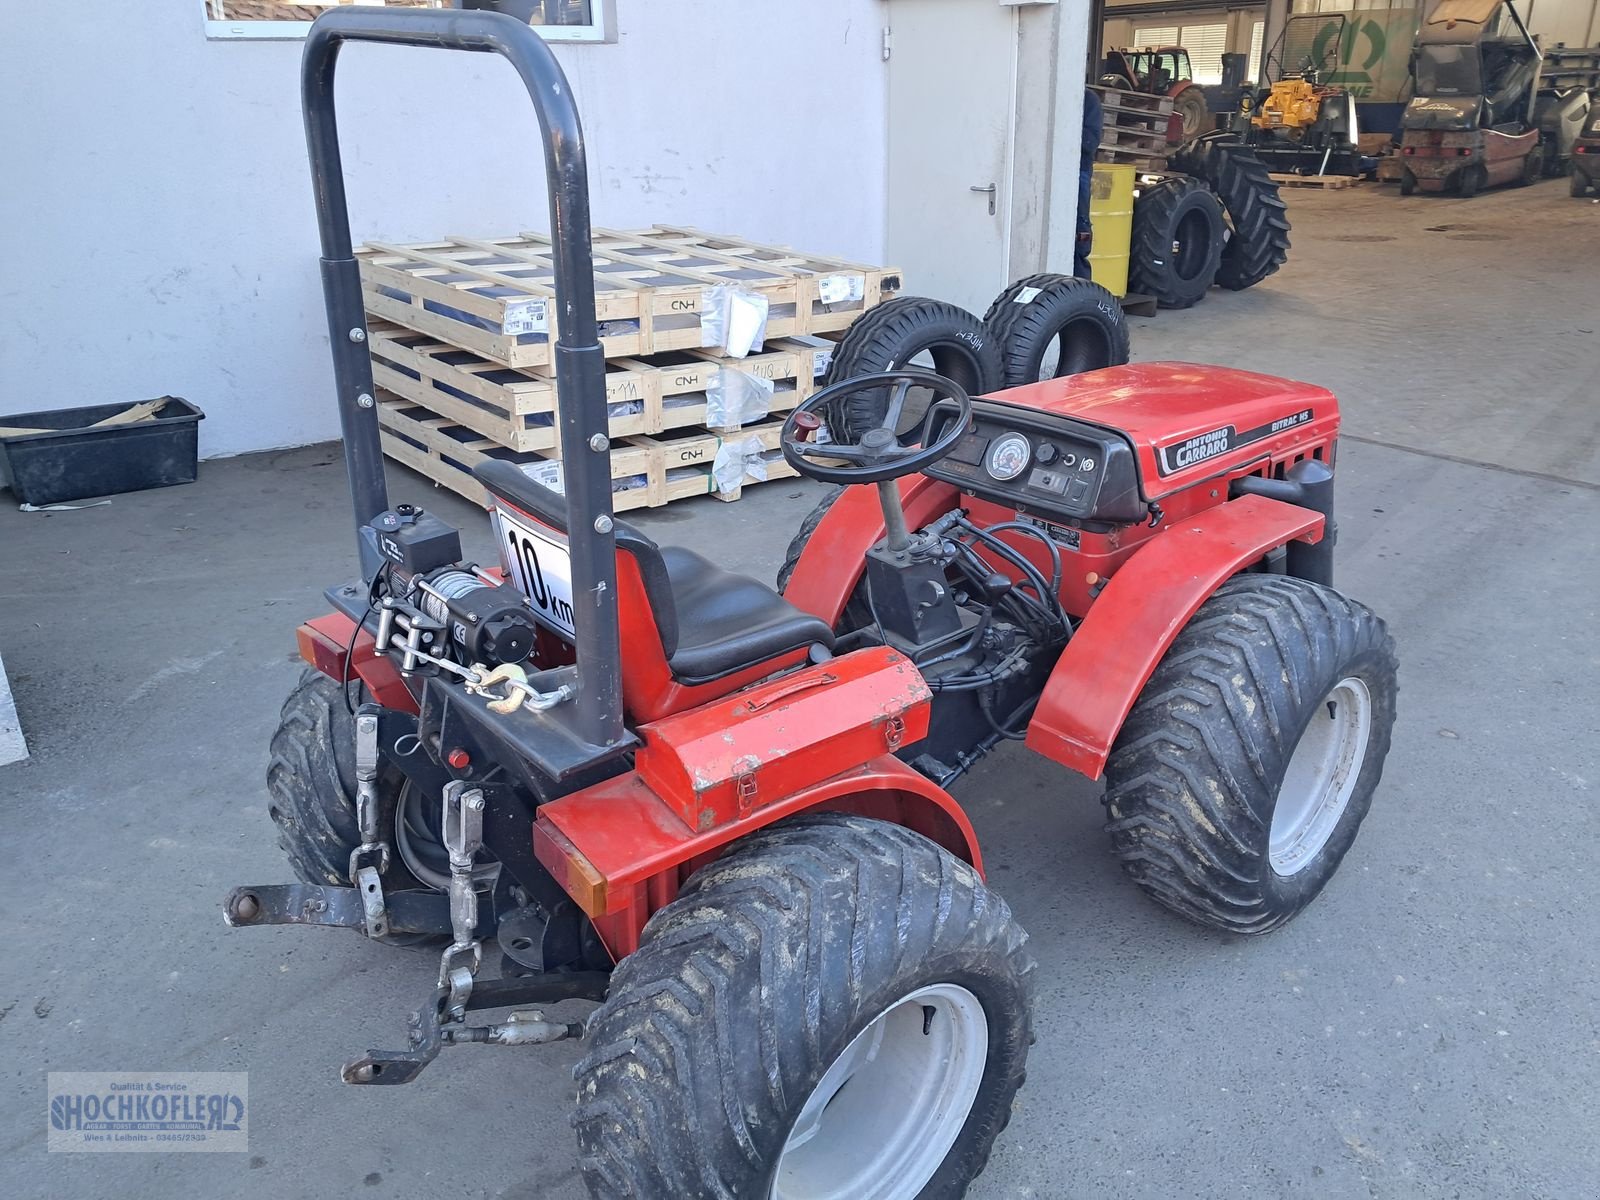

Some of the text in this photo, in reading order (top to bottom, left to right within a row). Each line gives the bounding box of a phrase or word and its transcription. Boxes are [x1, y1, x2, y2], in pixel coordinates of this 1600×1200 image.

[671, 300, 695, 311] CNH
[675, 375, 698, 386] CNH
[1271, 415, 1298, 432] BITRAC
[1185, 428, 1228, 450] ANTONIO
[680, 449, 703, 461] CNH
[1176, 438, 1228, 467] CARRARO
[509, 529, 548, 610] 10
[453, 624, 466, 643] CE
